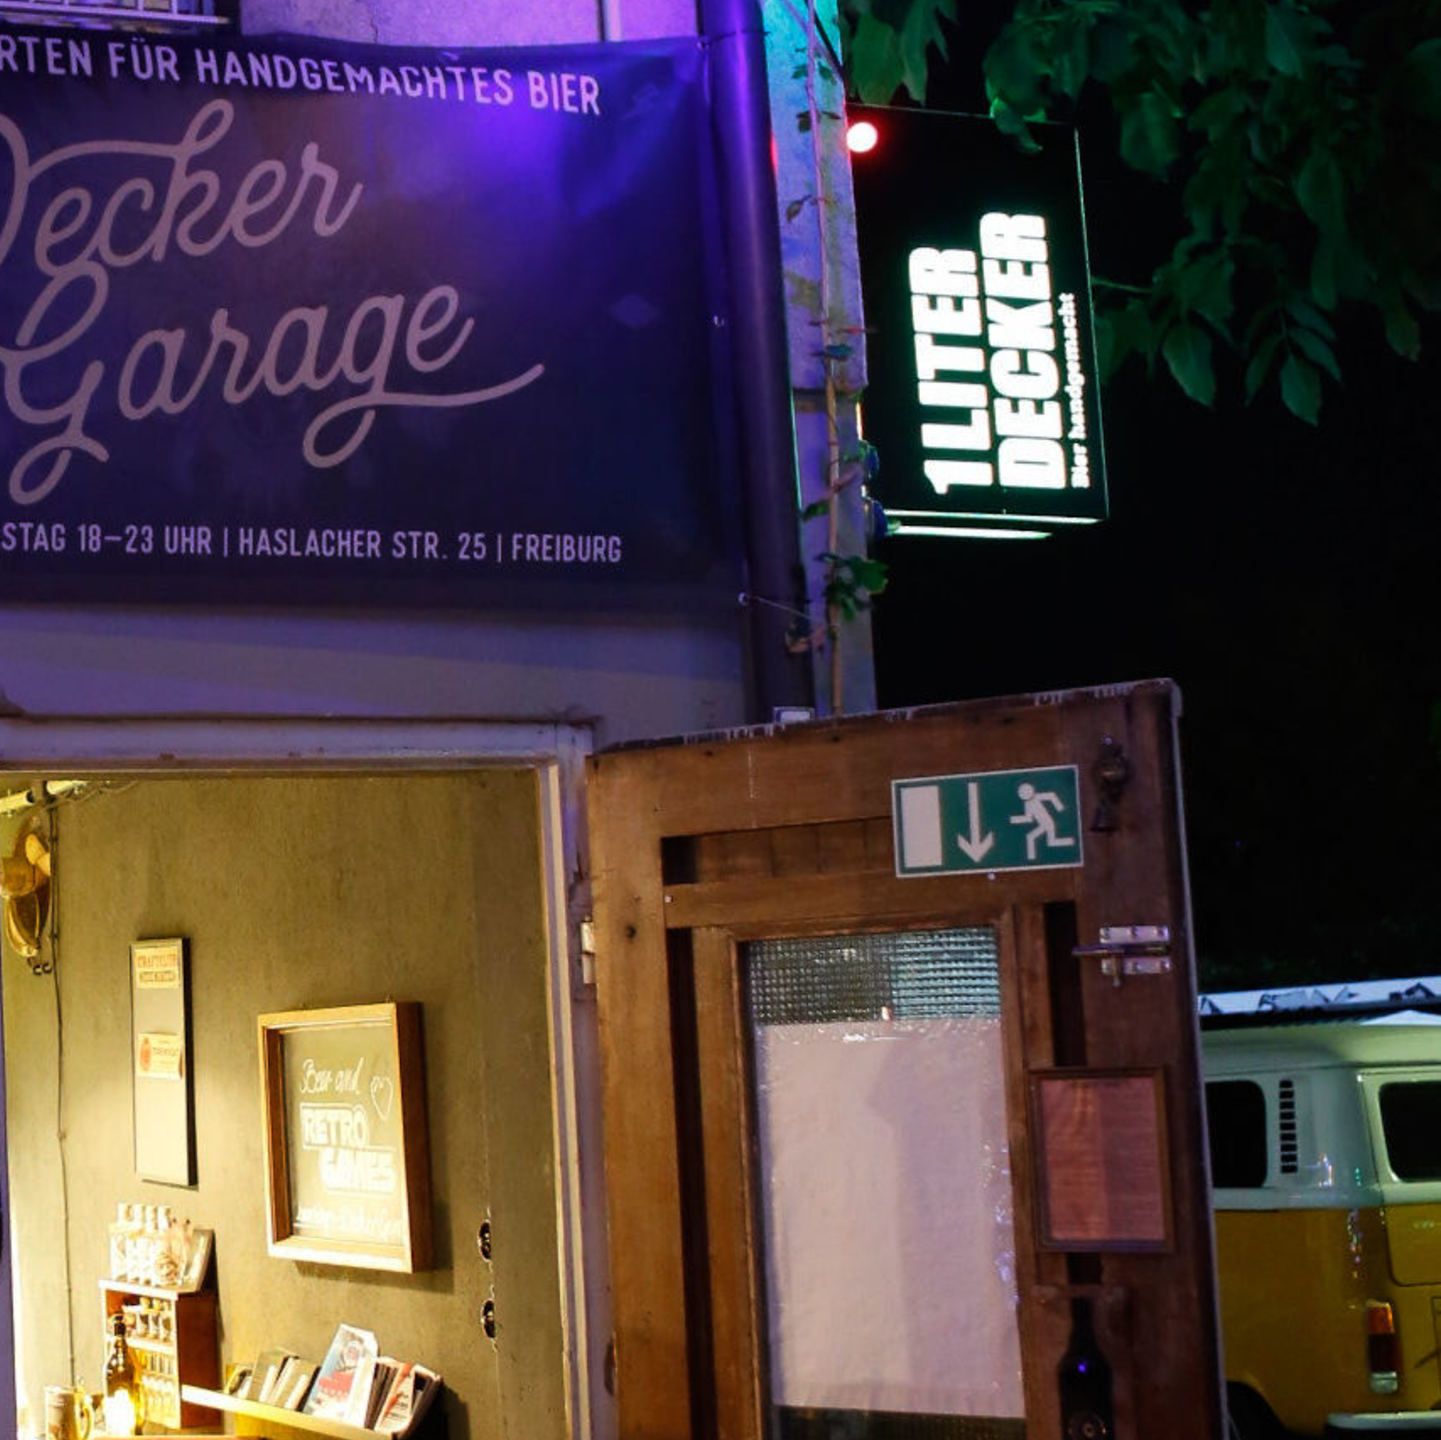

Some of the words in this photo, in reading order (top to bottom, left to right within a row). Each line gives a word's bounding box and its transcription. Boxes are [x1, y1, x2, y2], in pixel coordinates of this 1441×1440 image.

[110, 37, 180, 82] FÜR
[197, 49, 514, 107] HANDGEMACHTES
[529, 70, 601, 116] BIER
[980, 212, 1067, 490] DECKER
[164, 525, 213, 555] UHR
[239, 527, 382, 559] HASLACHER
[392, 531, 448, 560] STR.
[458, 532, 487, 561] 25
[512, 533, 623, 563] FREIBURG
[302, 1103, 368, 1148] RETRO
